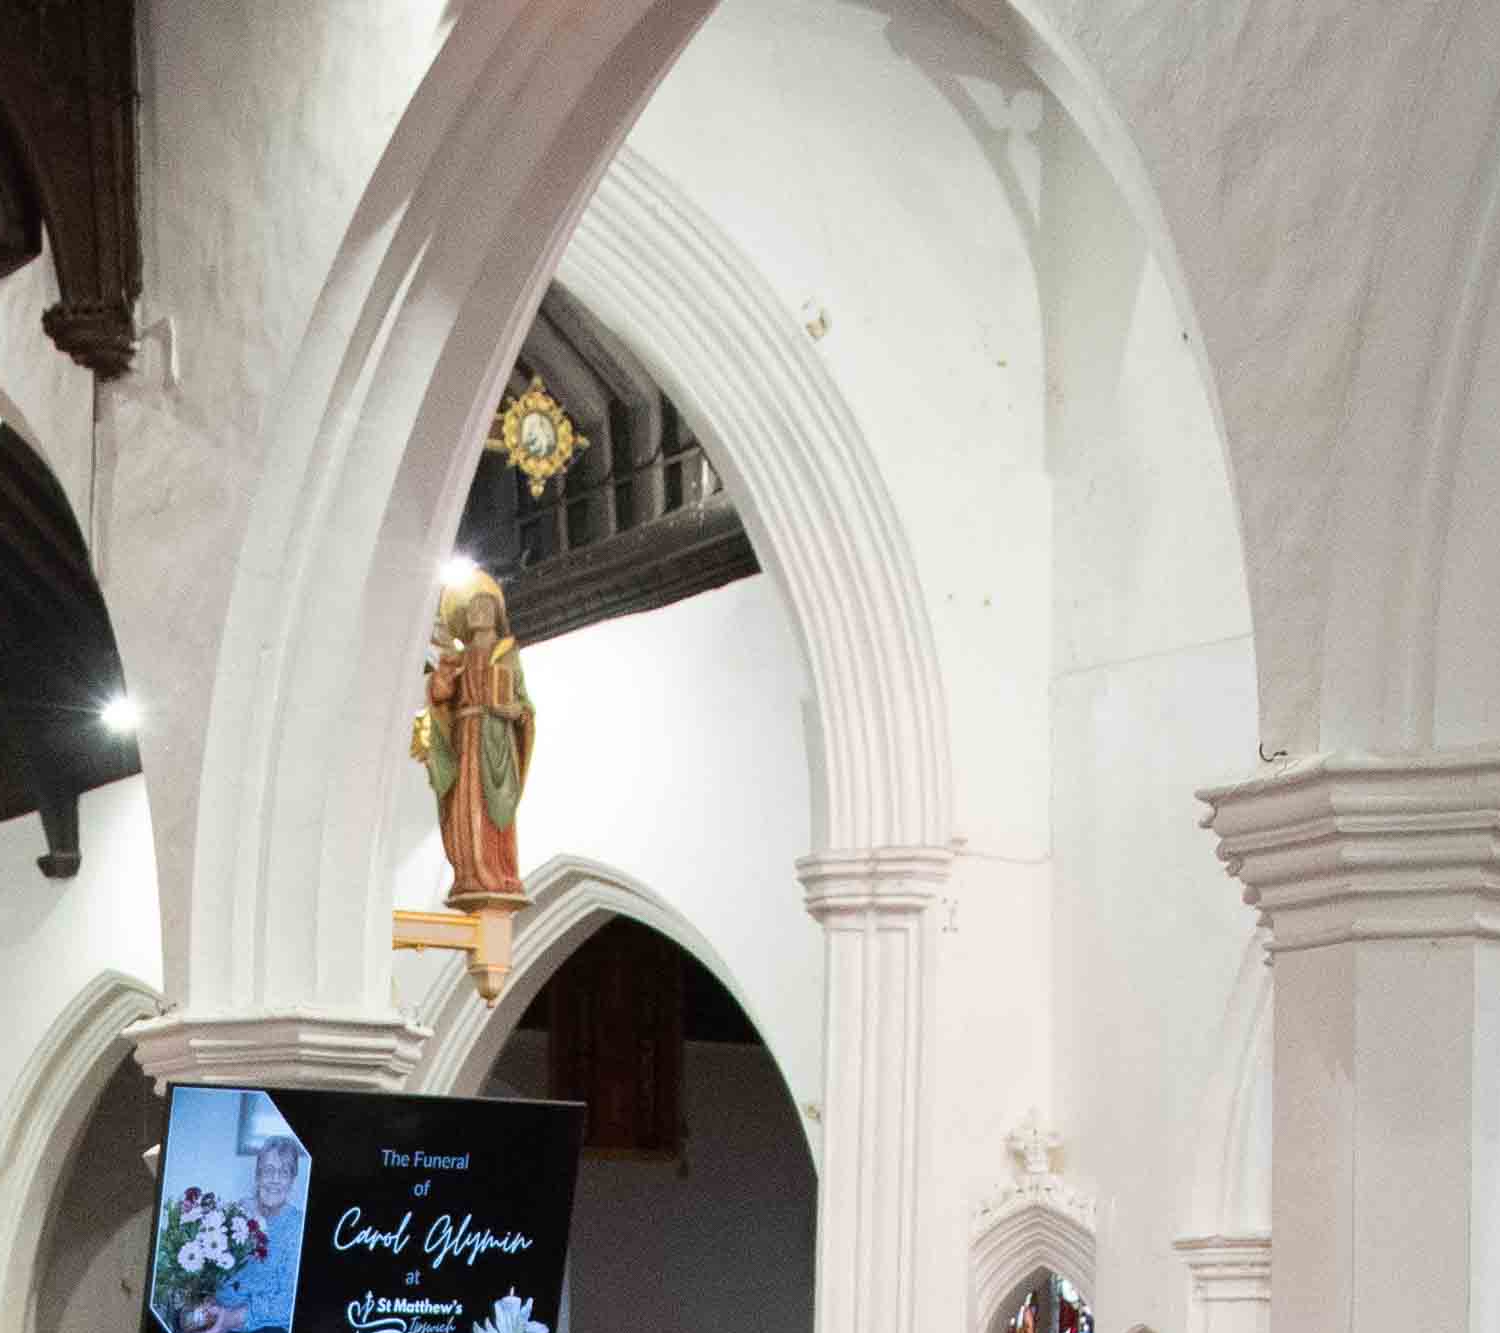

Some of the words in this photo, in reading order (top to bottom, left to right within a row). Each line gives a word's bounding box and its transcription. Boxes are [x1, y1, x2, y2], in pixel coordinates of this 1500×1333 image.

[381, 1149, 410, 1168] The
[414, 1151, 470, 1169] Funeral
[413, 1180, 431, 1197] of
[333, 1206, 413, 1255] Carol
[405, 1270, 421, 1286] at
[376, 1297, 392, 1314] St
[393, 1298, 463, 1315] Matthew's
